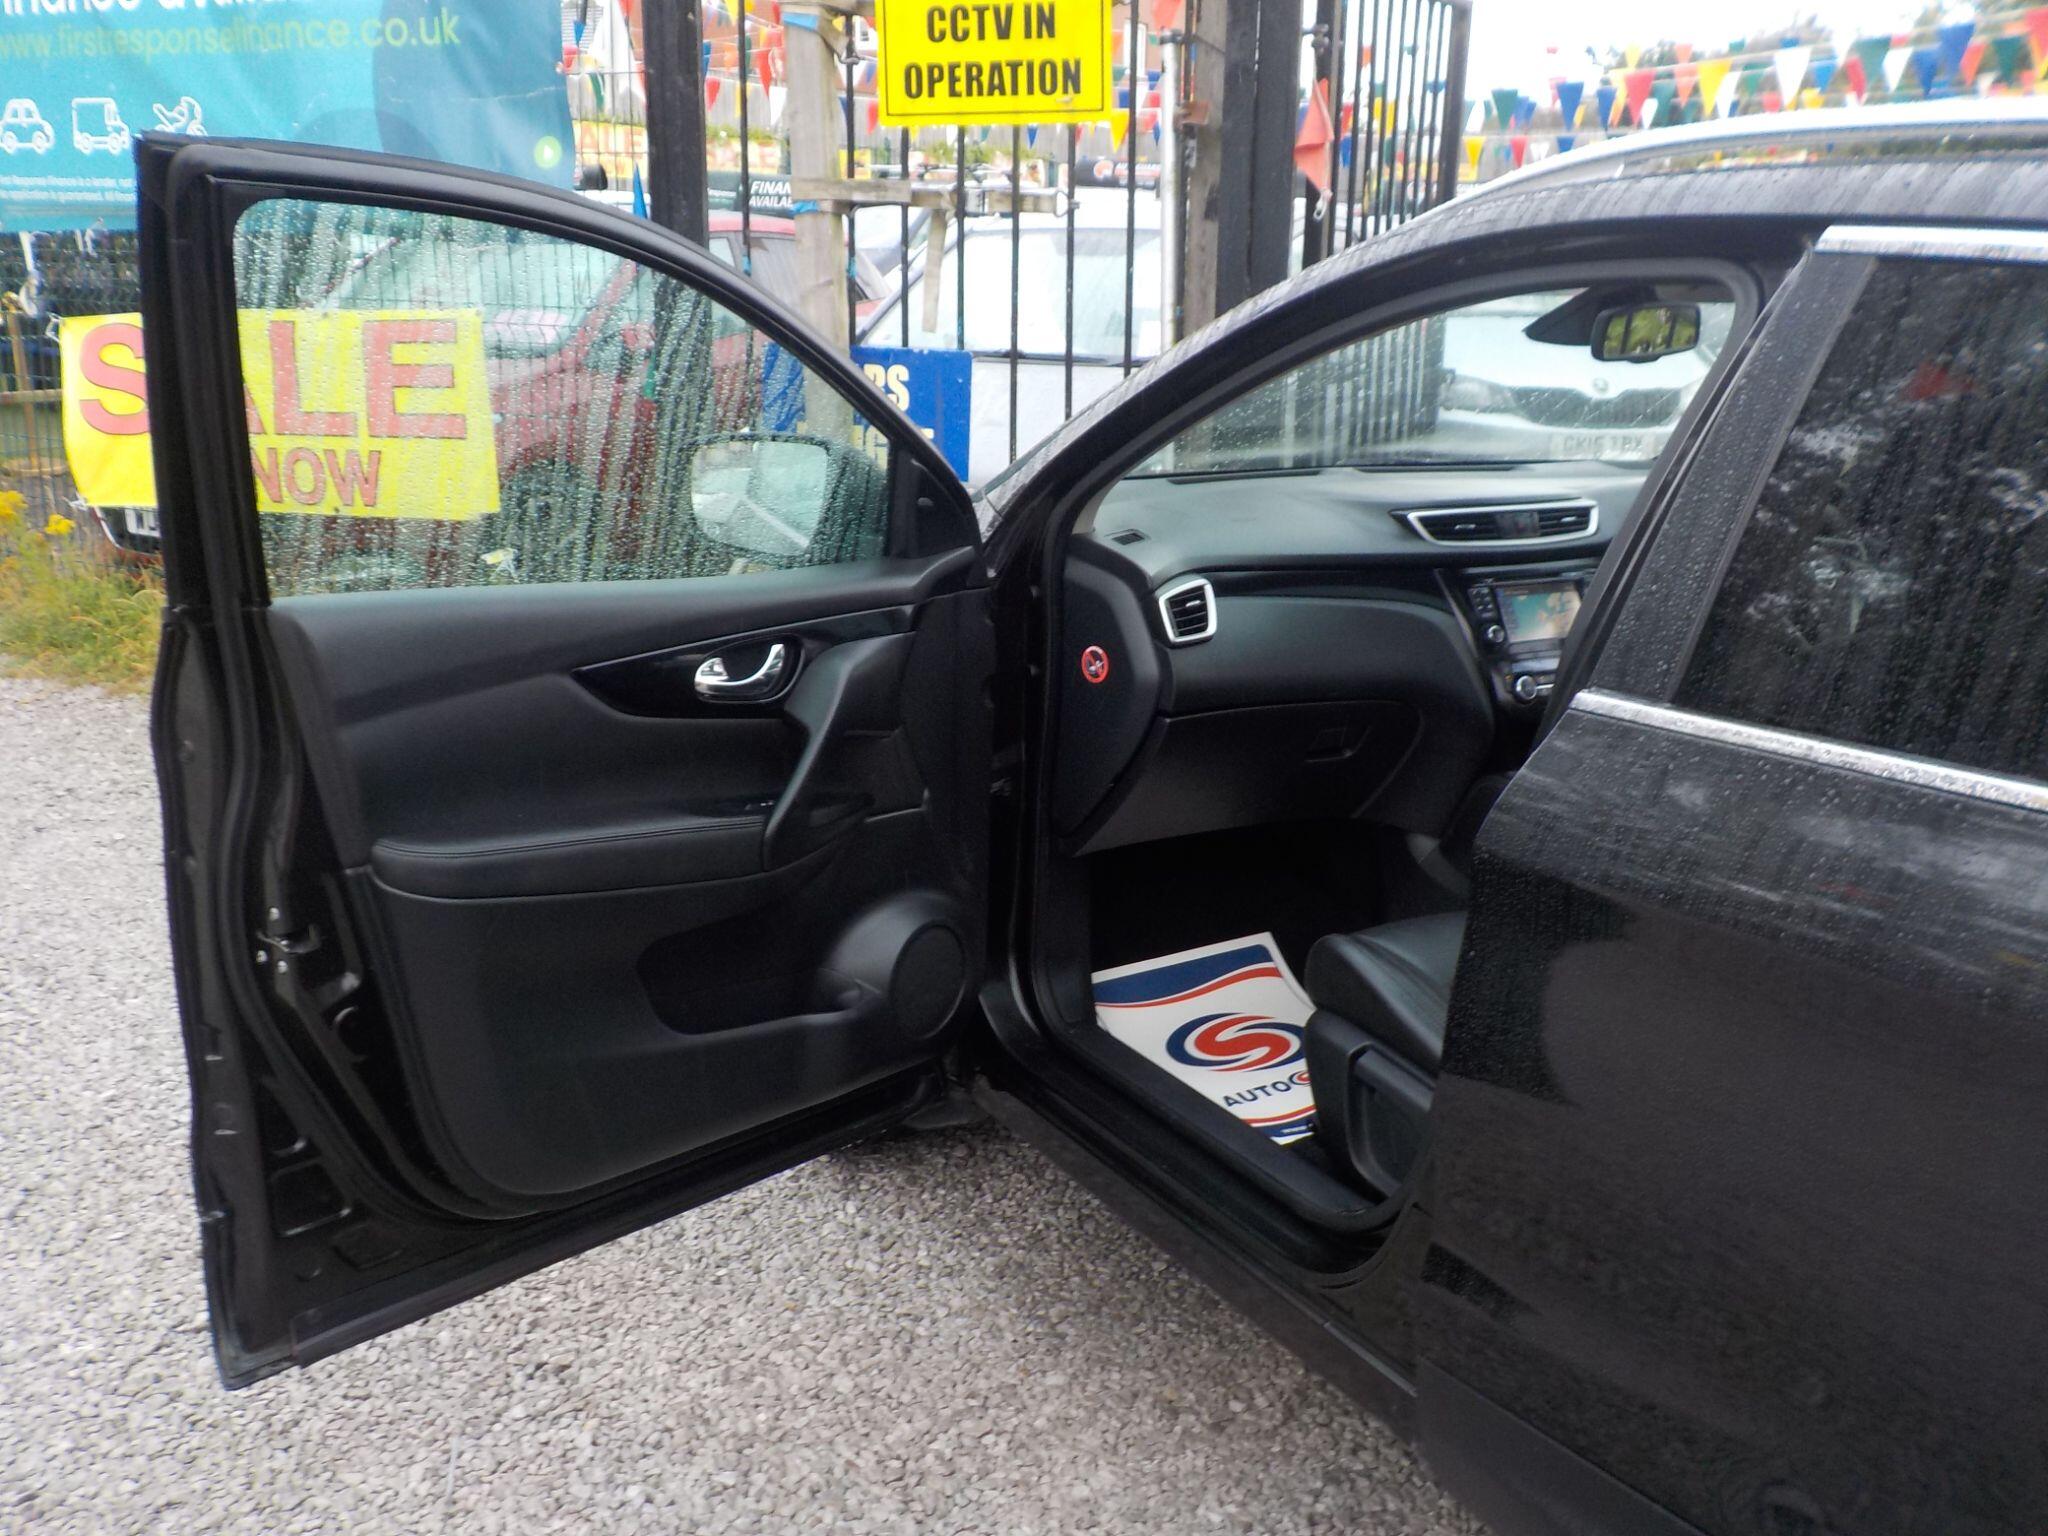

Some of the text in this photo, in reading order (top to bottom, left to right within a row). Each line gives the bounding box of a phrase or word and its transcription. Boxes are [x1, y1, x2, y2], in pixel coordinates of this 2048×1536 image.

[927, 2, 1056, 43] CCTV IN
[904, 58, 1082, 99] OPERATION
[79, 319, 468, 440] SLE
[250, 446, 382, 507] NOW
